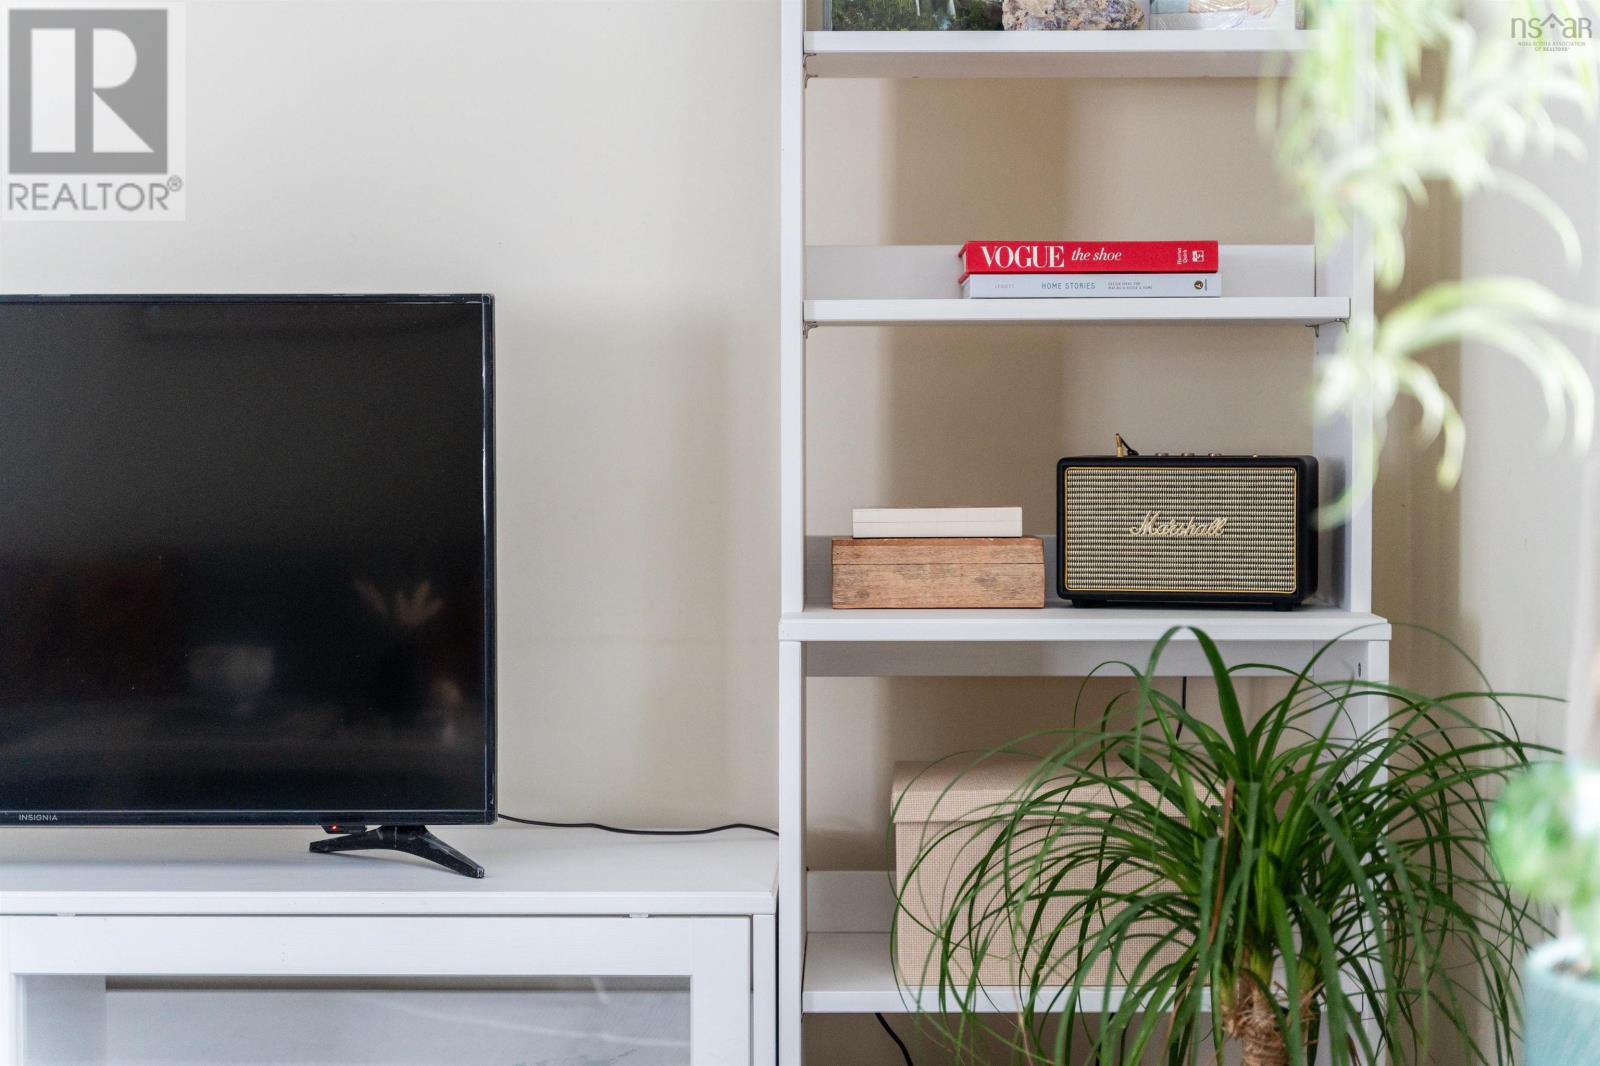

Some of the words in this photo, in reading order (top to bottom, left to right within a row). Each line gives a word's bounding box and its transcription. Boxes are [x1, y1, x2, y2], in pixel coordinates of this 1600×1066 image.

[980, 245, 1065, 269] VOGUE
[1071, 247, 1091, 261] the
[1093, 247, 1122, 261] shoe
[1041, 282, 1062, 290] HOME
[1065, 282, 1096, 290] STORIES
[1129, 510, 1228, 536] Marshall
